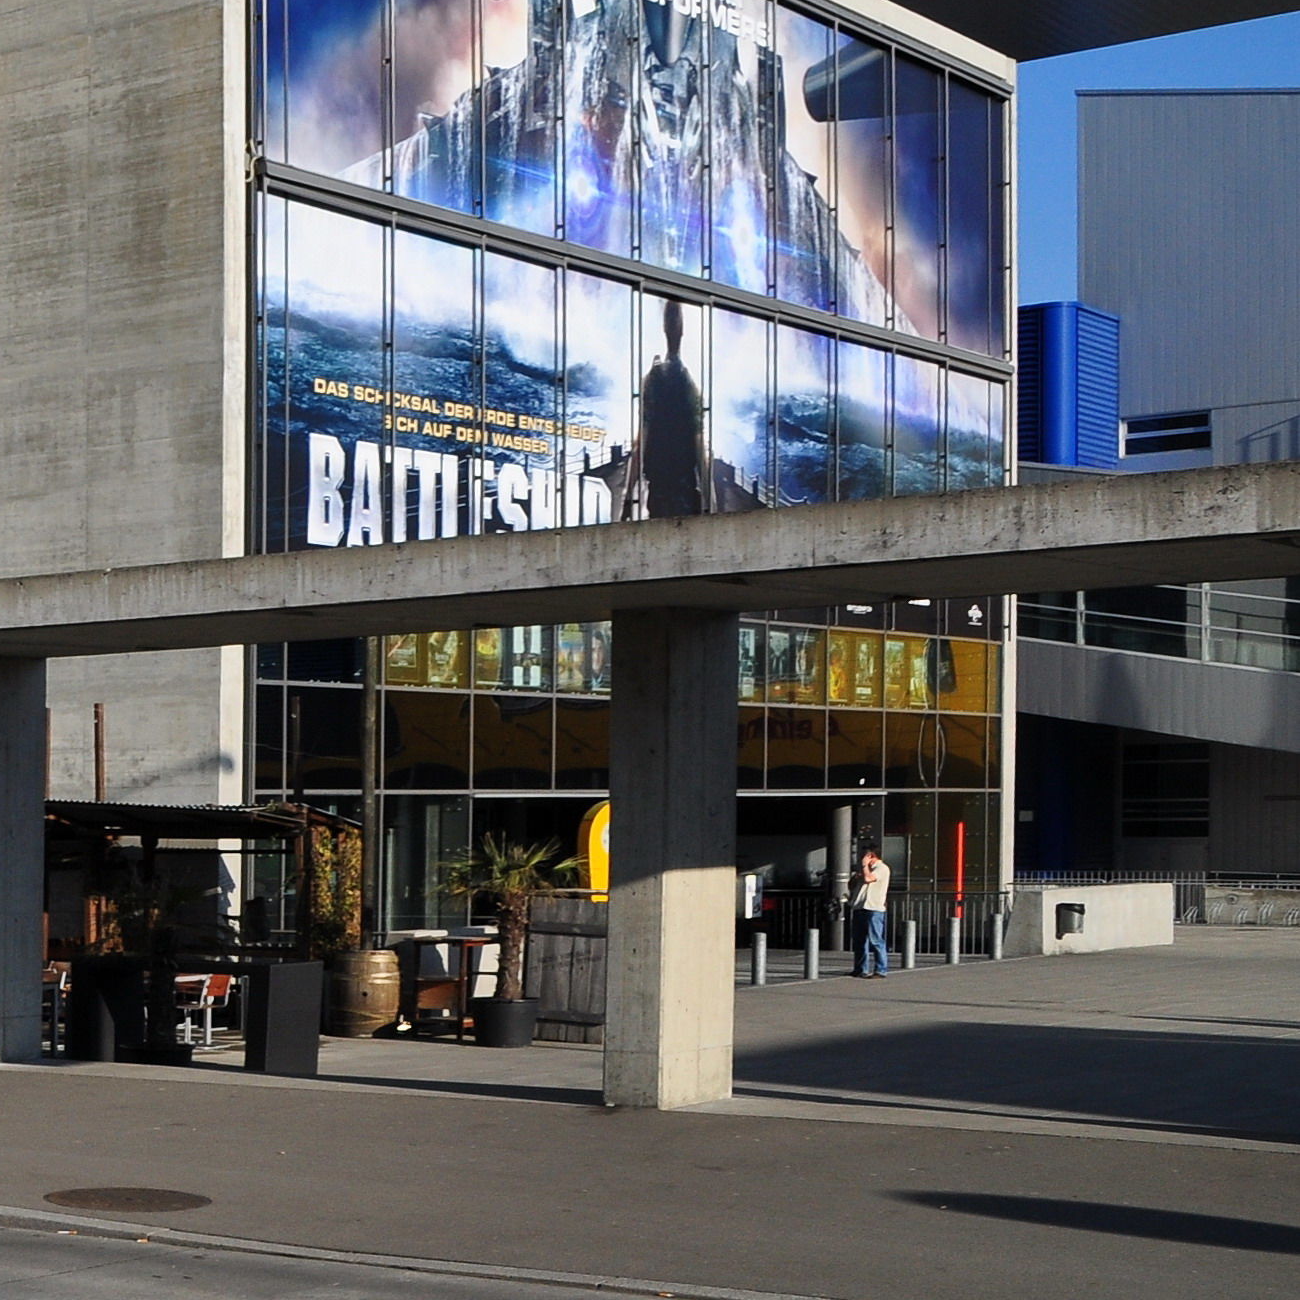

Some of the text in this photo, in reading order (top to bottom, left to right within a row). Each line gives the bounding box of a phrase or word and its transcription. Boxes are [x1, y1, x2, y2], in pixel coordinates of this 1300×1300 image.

[314, 377, 349, 399] DAS
[444, 402, 474, 421] DER
[385, 414, 419, 433] SCH
[422, 421, 453, 438] AUF
